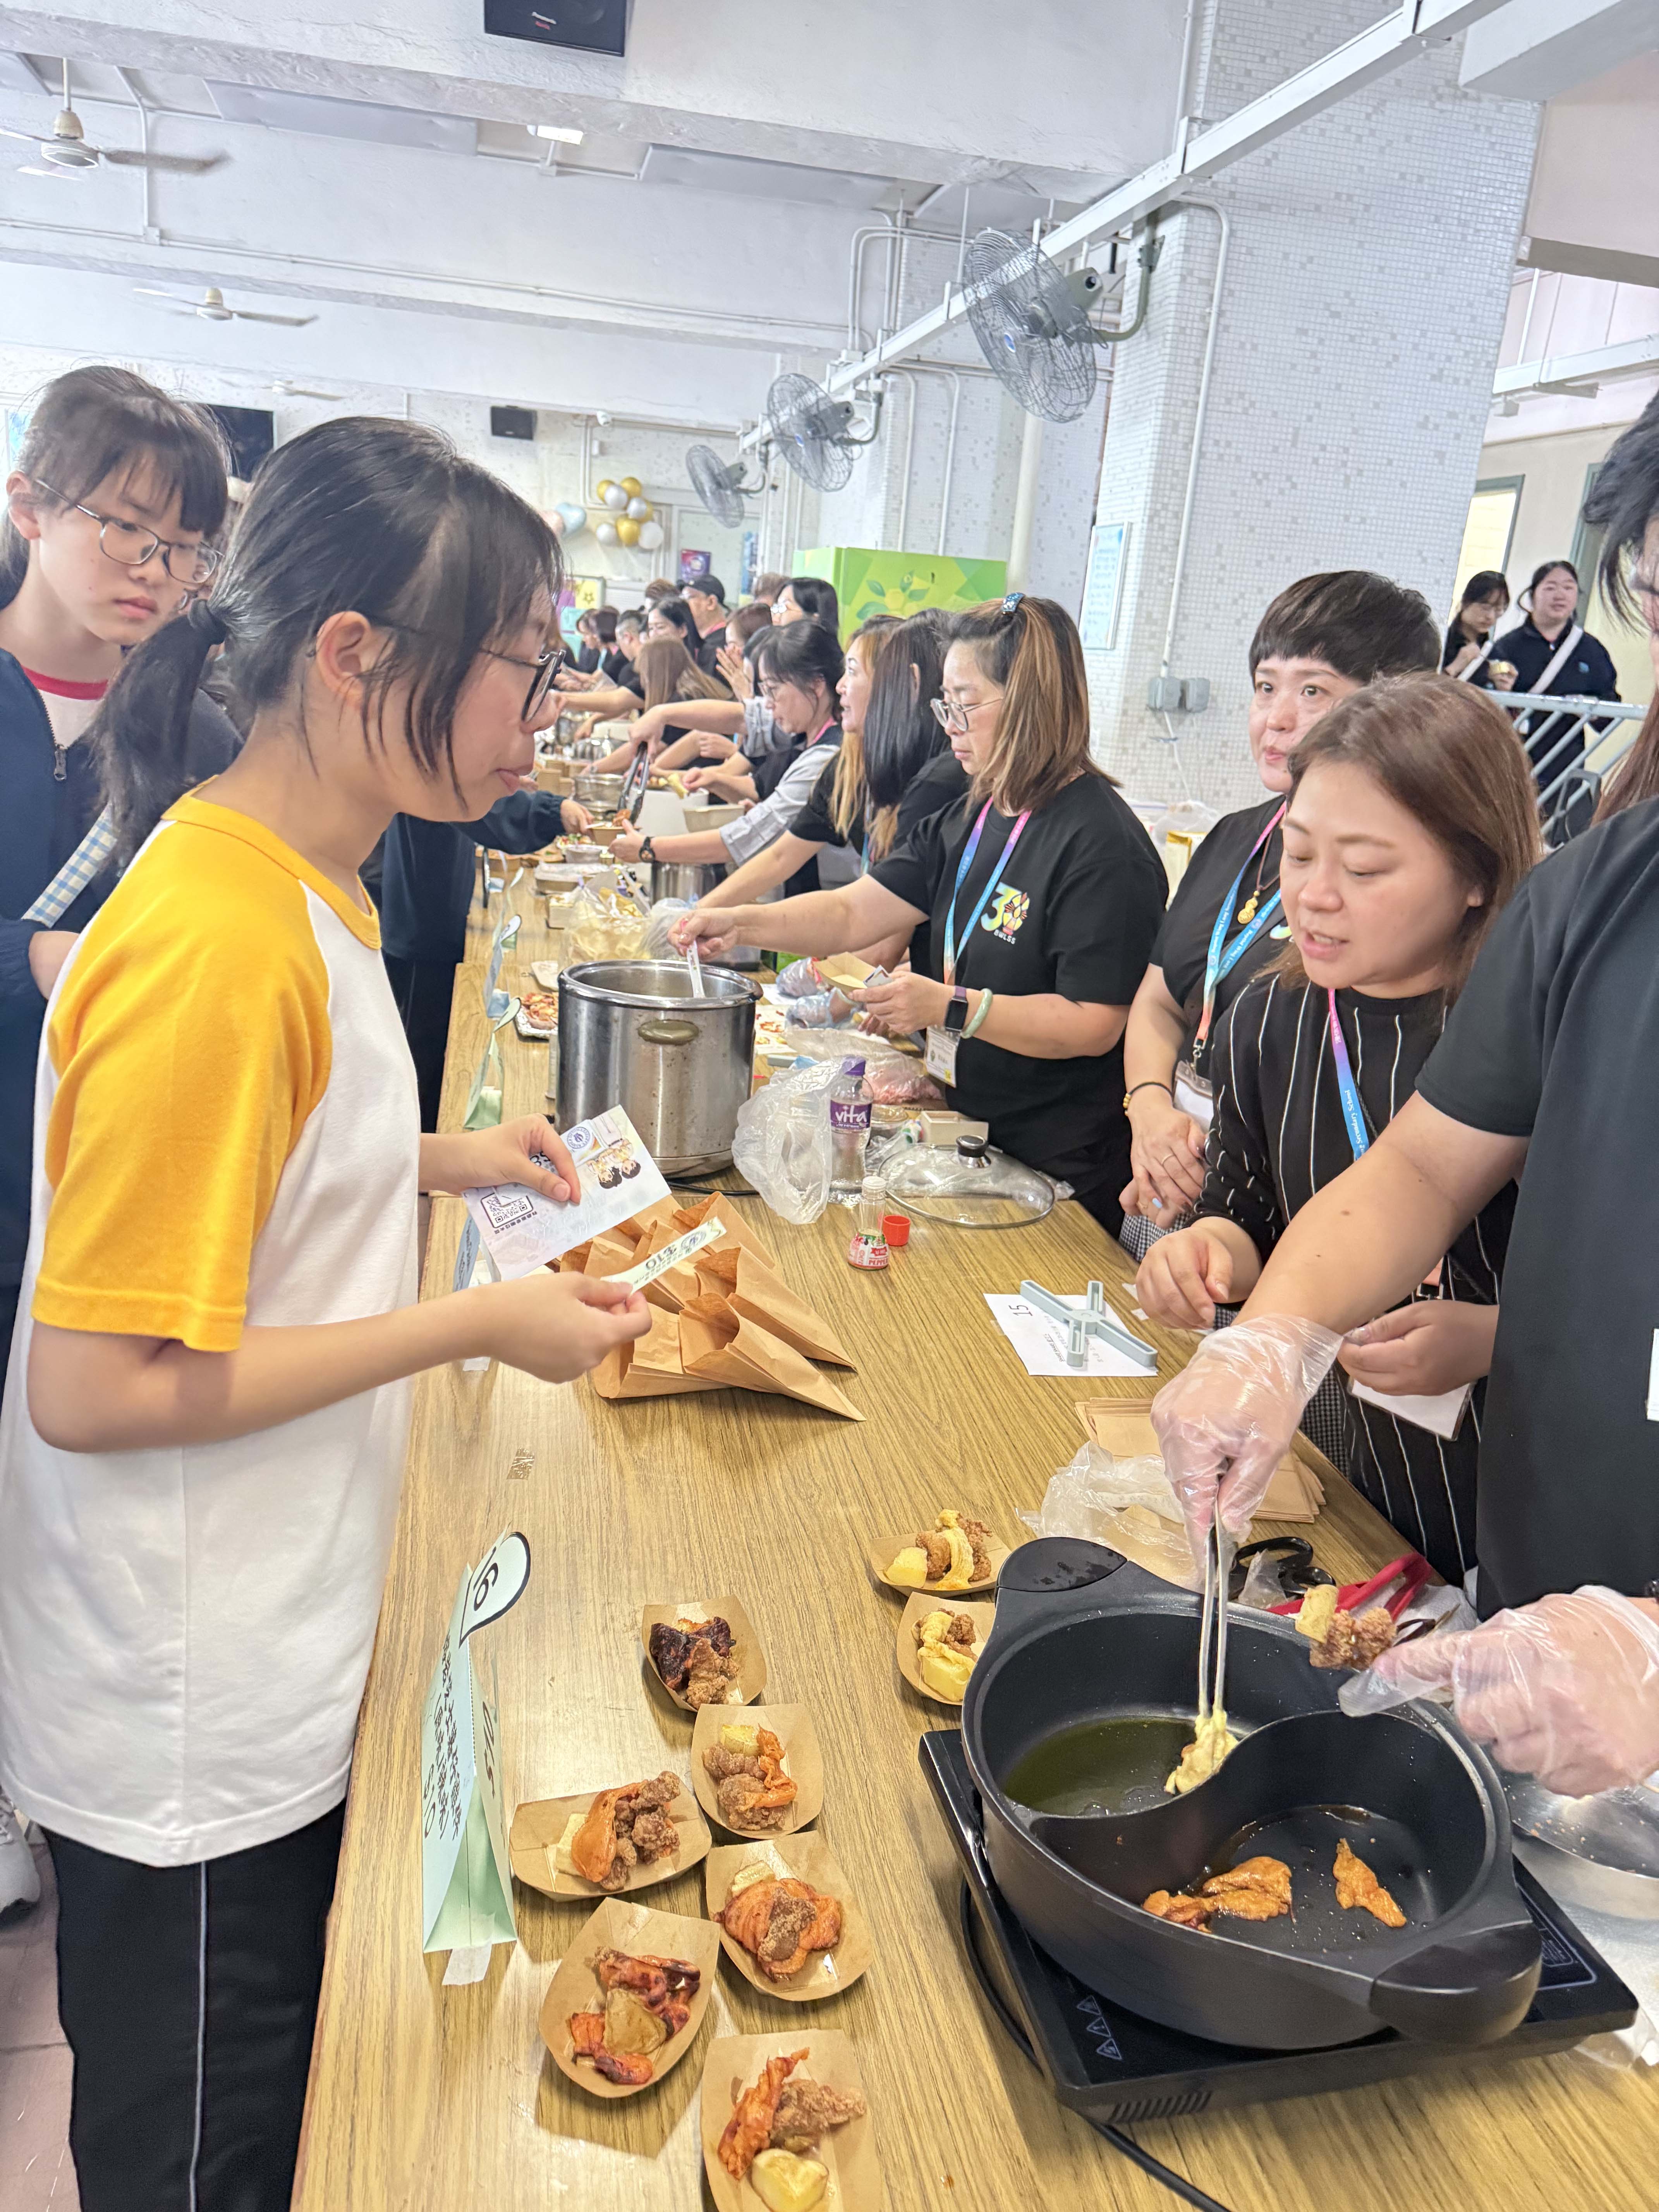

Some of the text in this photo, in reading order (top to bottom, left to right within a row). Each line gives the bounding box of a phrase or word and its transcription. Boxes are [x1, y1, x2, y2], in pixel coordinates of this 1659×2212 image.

[994, 929, 1016, 945] BWLSS
[1345, 1089, 1355, 1111] School
[835, 1105, 867, 1123] vita
[1350, 1113, 1363, 1144] Secondary
[1008, 1305, 1033, 1317] 15
[473, 1546, 499, 1611] 16
[424, 1763, 436, 1839] $10
